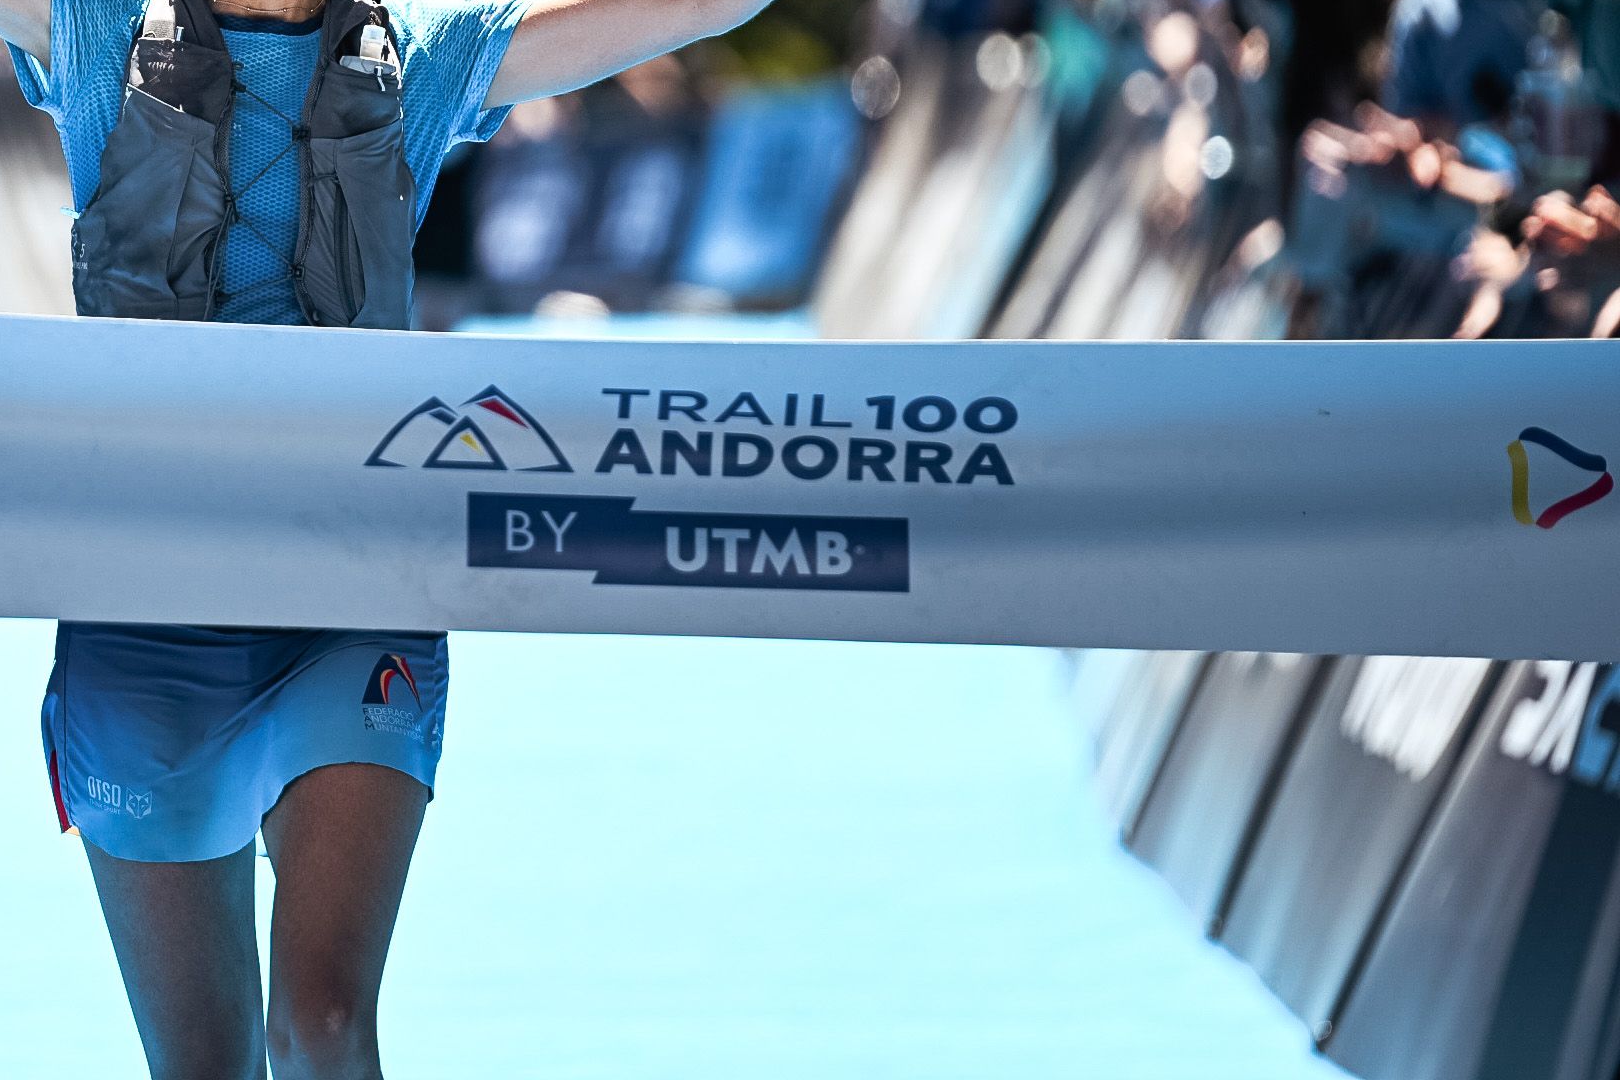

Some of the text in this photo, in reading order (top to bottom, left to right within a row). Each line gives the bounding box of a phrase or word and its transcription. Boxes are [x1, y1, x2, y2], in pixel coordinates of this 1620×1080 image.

[602, 388, 1019, 434] TRAIL 100
[594, 428, 1015, 485] ANDORRA
[505, 511, 577, 552] BY
[87, 775, 121, 808] OTSO
